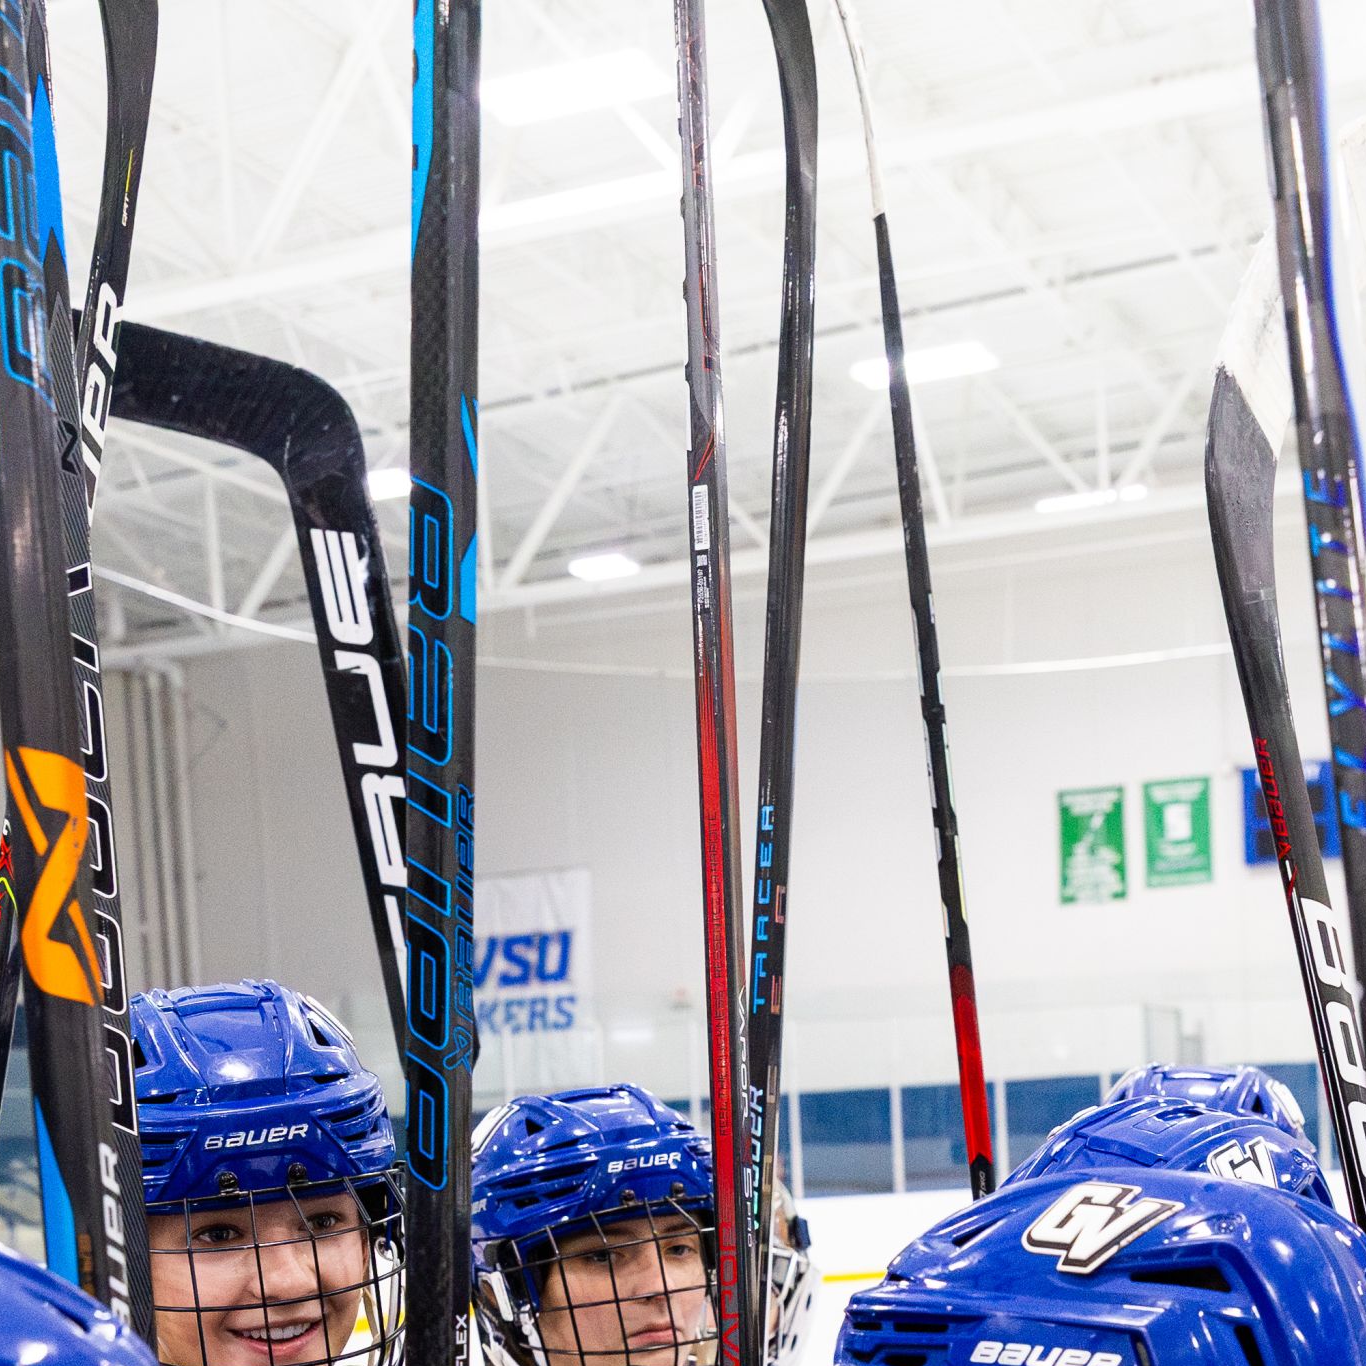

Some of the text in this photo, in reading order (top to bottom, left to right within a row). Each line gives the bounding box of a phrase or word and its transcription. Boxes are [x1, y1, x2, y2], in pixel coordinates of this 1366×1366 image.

[1254, 737, 1289, 838] BAUER
[472, 929, 575, 988] VSU
[476, 995, 576, 1034] KERS
[203, 1122, 309, 1151] BAUER
[607, 1151, 682, 1174] BAUER
[97, 1142, 131, 1328] AUER
[1021, 1181, 1185, 1275] GV
